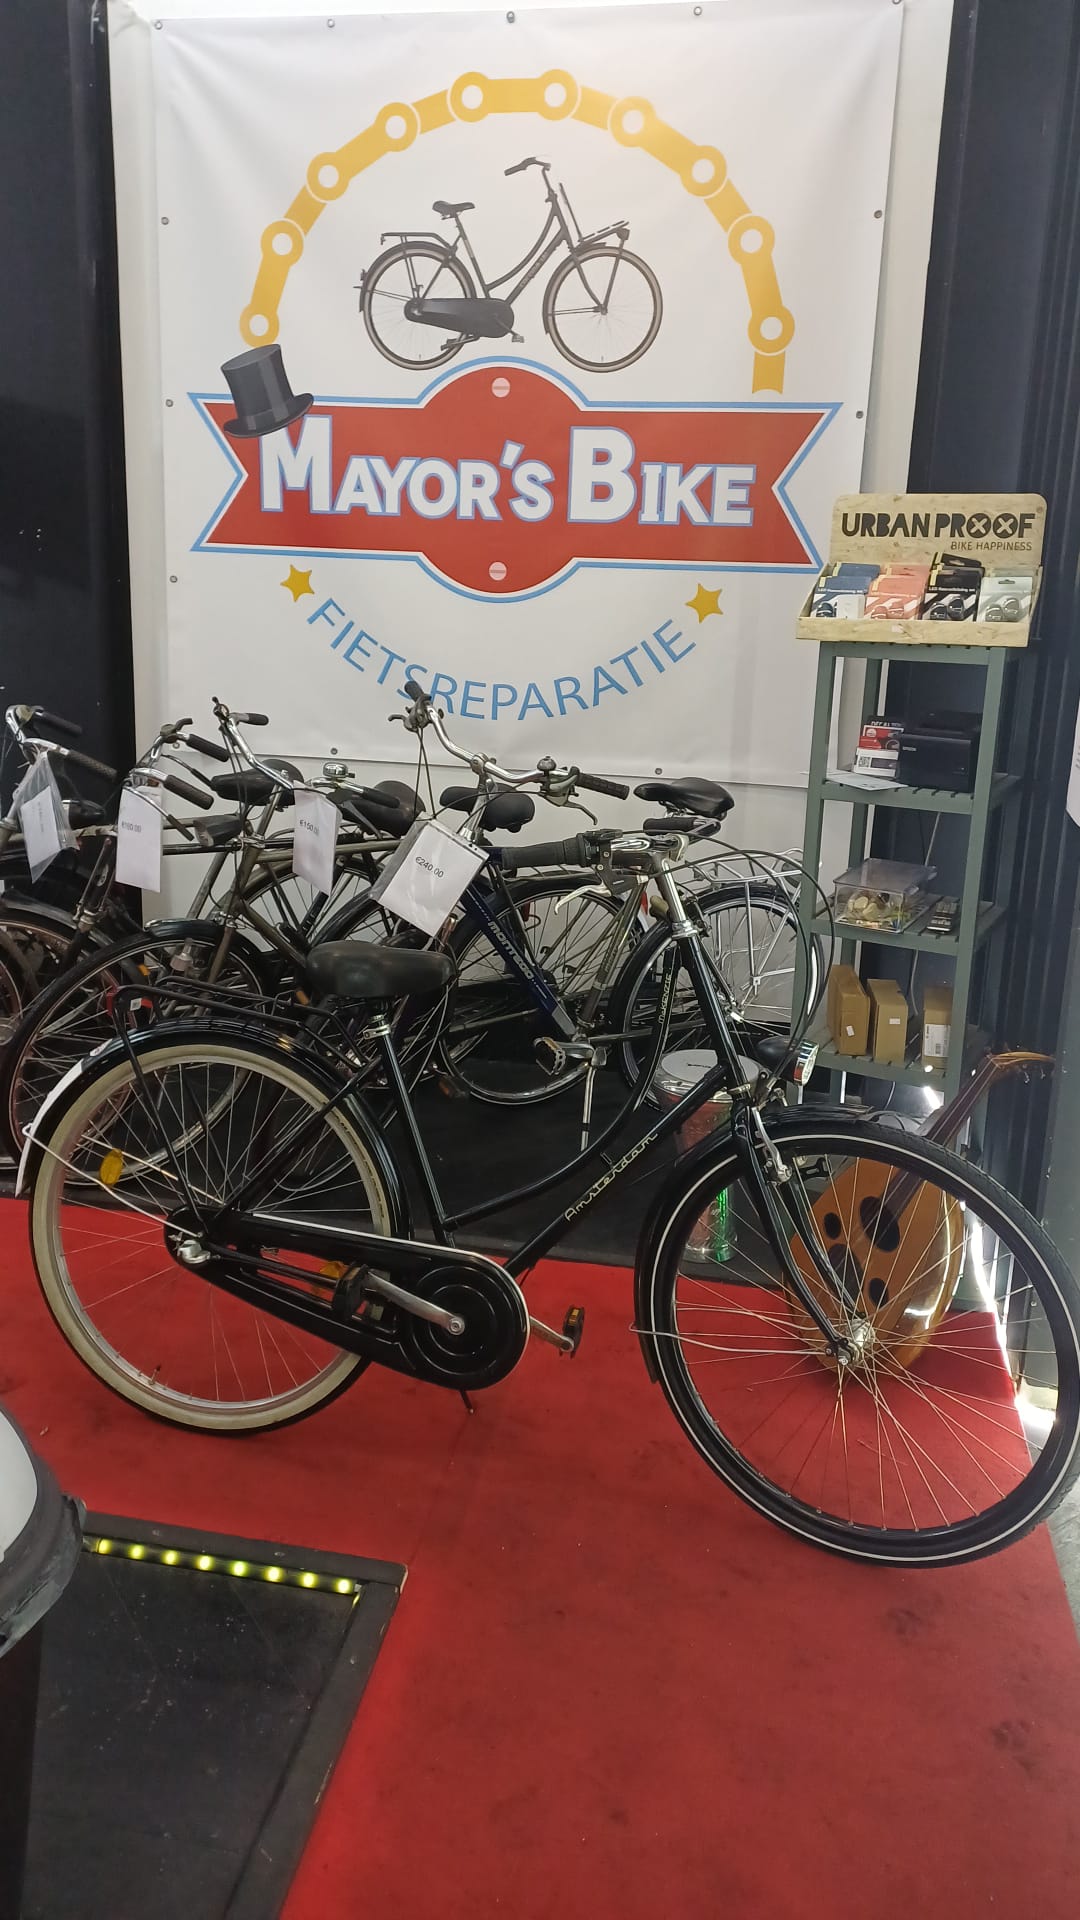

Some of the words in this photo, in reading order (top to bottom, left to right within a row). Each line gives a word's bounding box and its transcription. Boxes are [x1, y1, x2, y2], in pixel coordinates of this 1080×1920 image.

[568, 426, 757, 526] BIKE
[950, 541, 973, 551] BIKE
[976, 541, 1033, 551] HAPPINESS
[306, 597, 696, 721] FIETSREPARATIE
[415, 856, 444, 878] €240.00
[564, 1132, 659, 1222] Amsterdam
